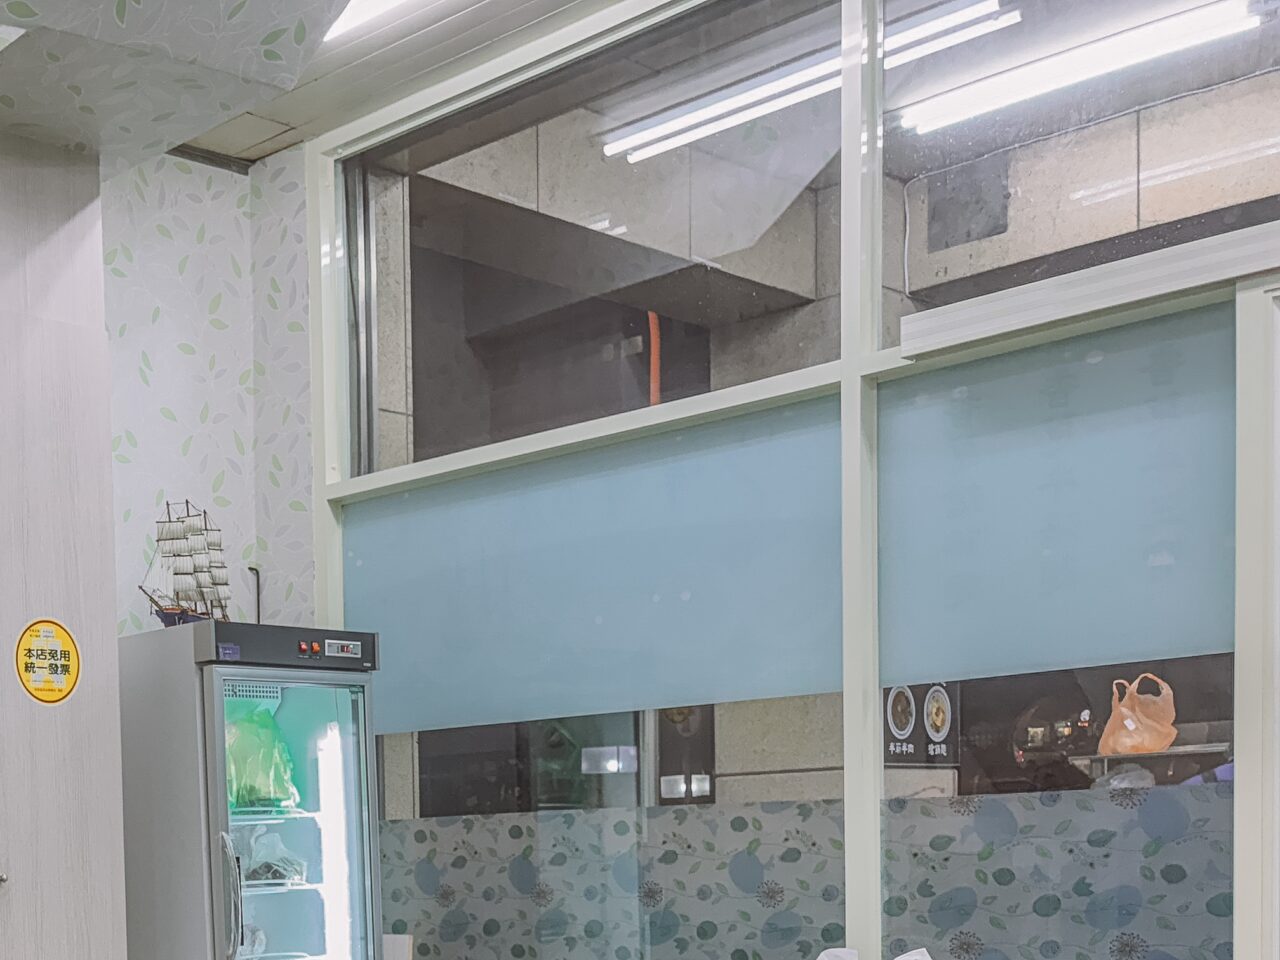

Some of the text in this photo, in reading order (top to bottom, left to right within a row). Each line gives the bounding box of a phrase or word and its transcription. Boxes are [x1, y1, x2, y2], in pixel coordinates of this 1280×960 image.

[23, 648, 70, 662] 本店免用
[23, 661, 71, 676] 統一發票
